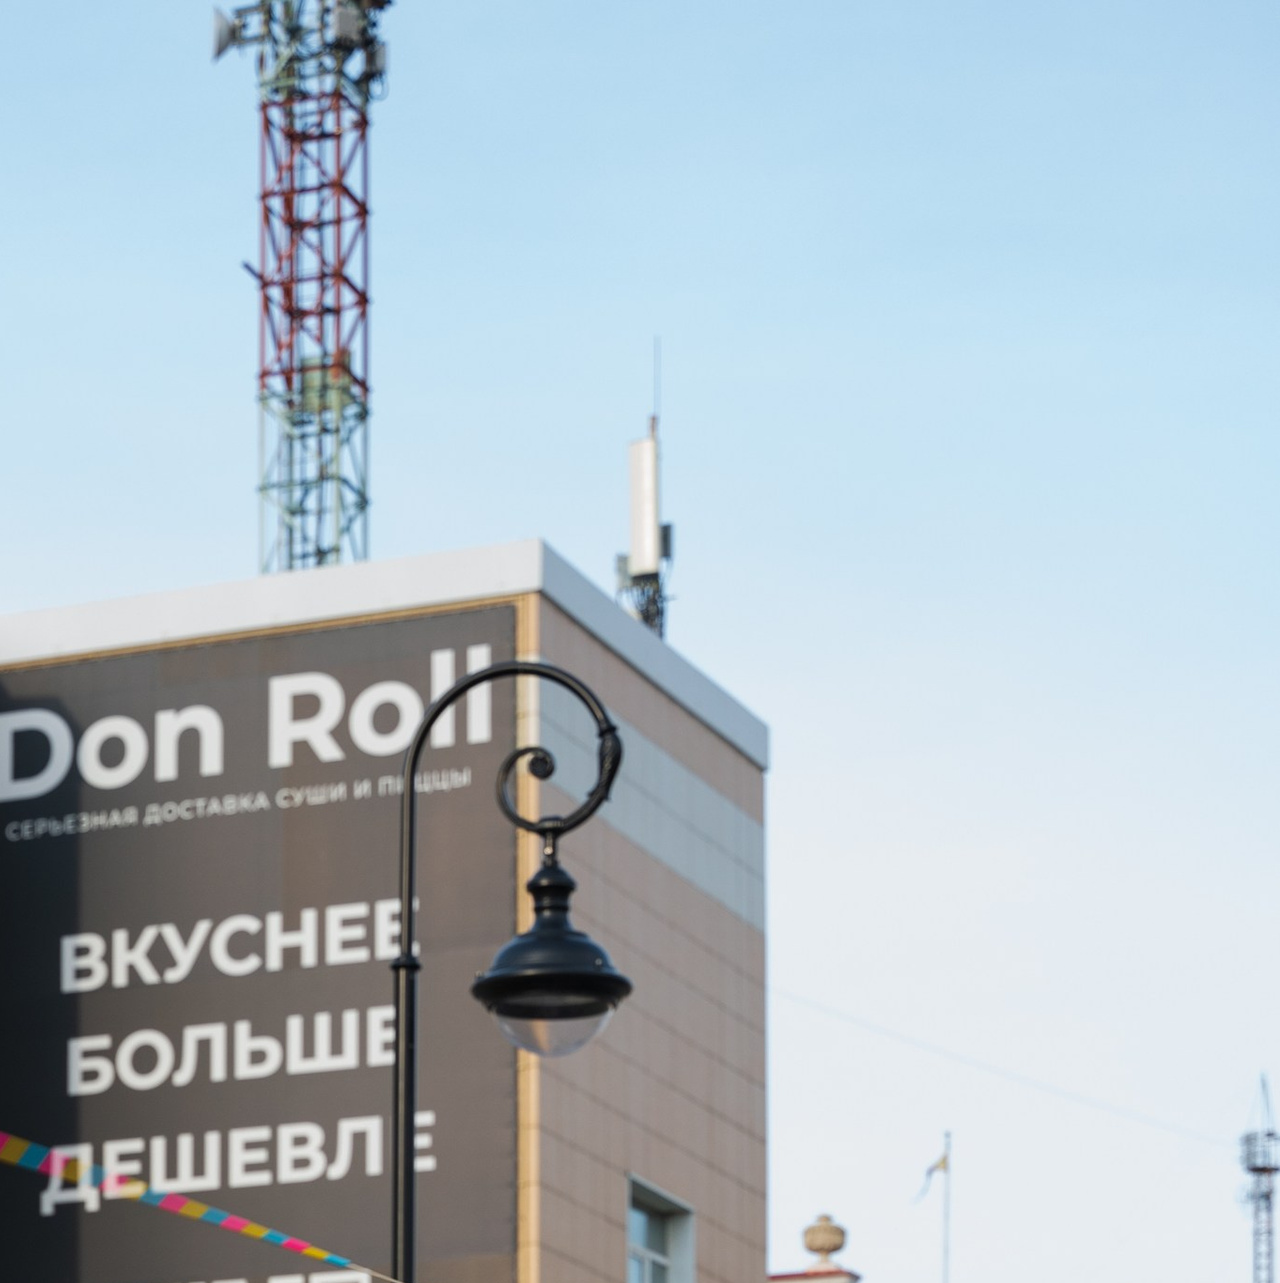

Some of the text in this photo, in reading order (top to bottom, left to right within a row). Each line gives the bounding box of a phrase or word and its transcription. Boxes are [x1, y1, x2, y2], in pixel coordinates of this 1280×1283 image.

[267, 643, 492, 769] Roll
[5, 805, 138, 841] СЕРЬЕЗНАЯ
[142, 792, 270, 827] ДОСТАВКА
[275, 781, 347, 808] СУШИ
[353, 777, 372, 799] И
[60, 896, 420, 993] ВКУСНЕЕ
[67, 1004, 396, 1096] БОЛЬШЕ
